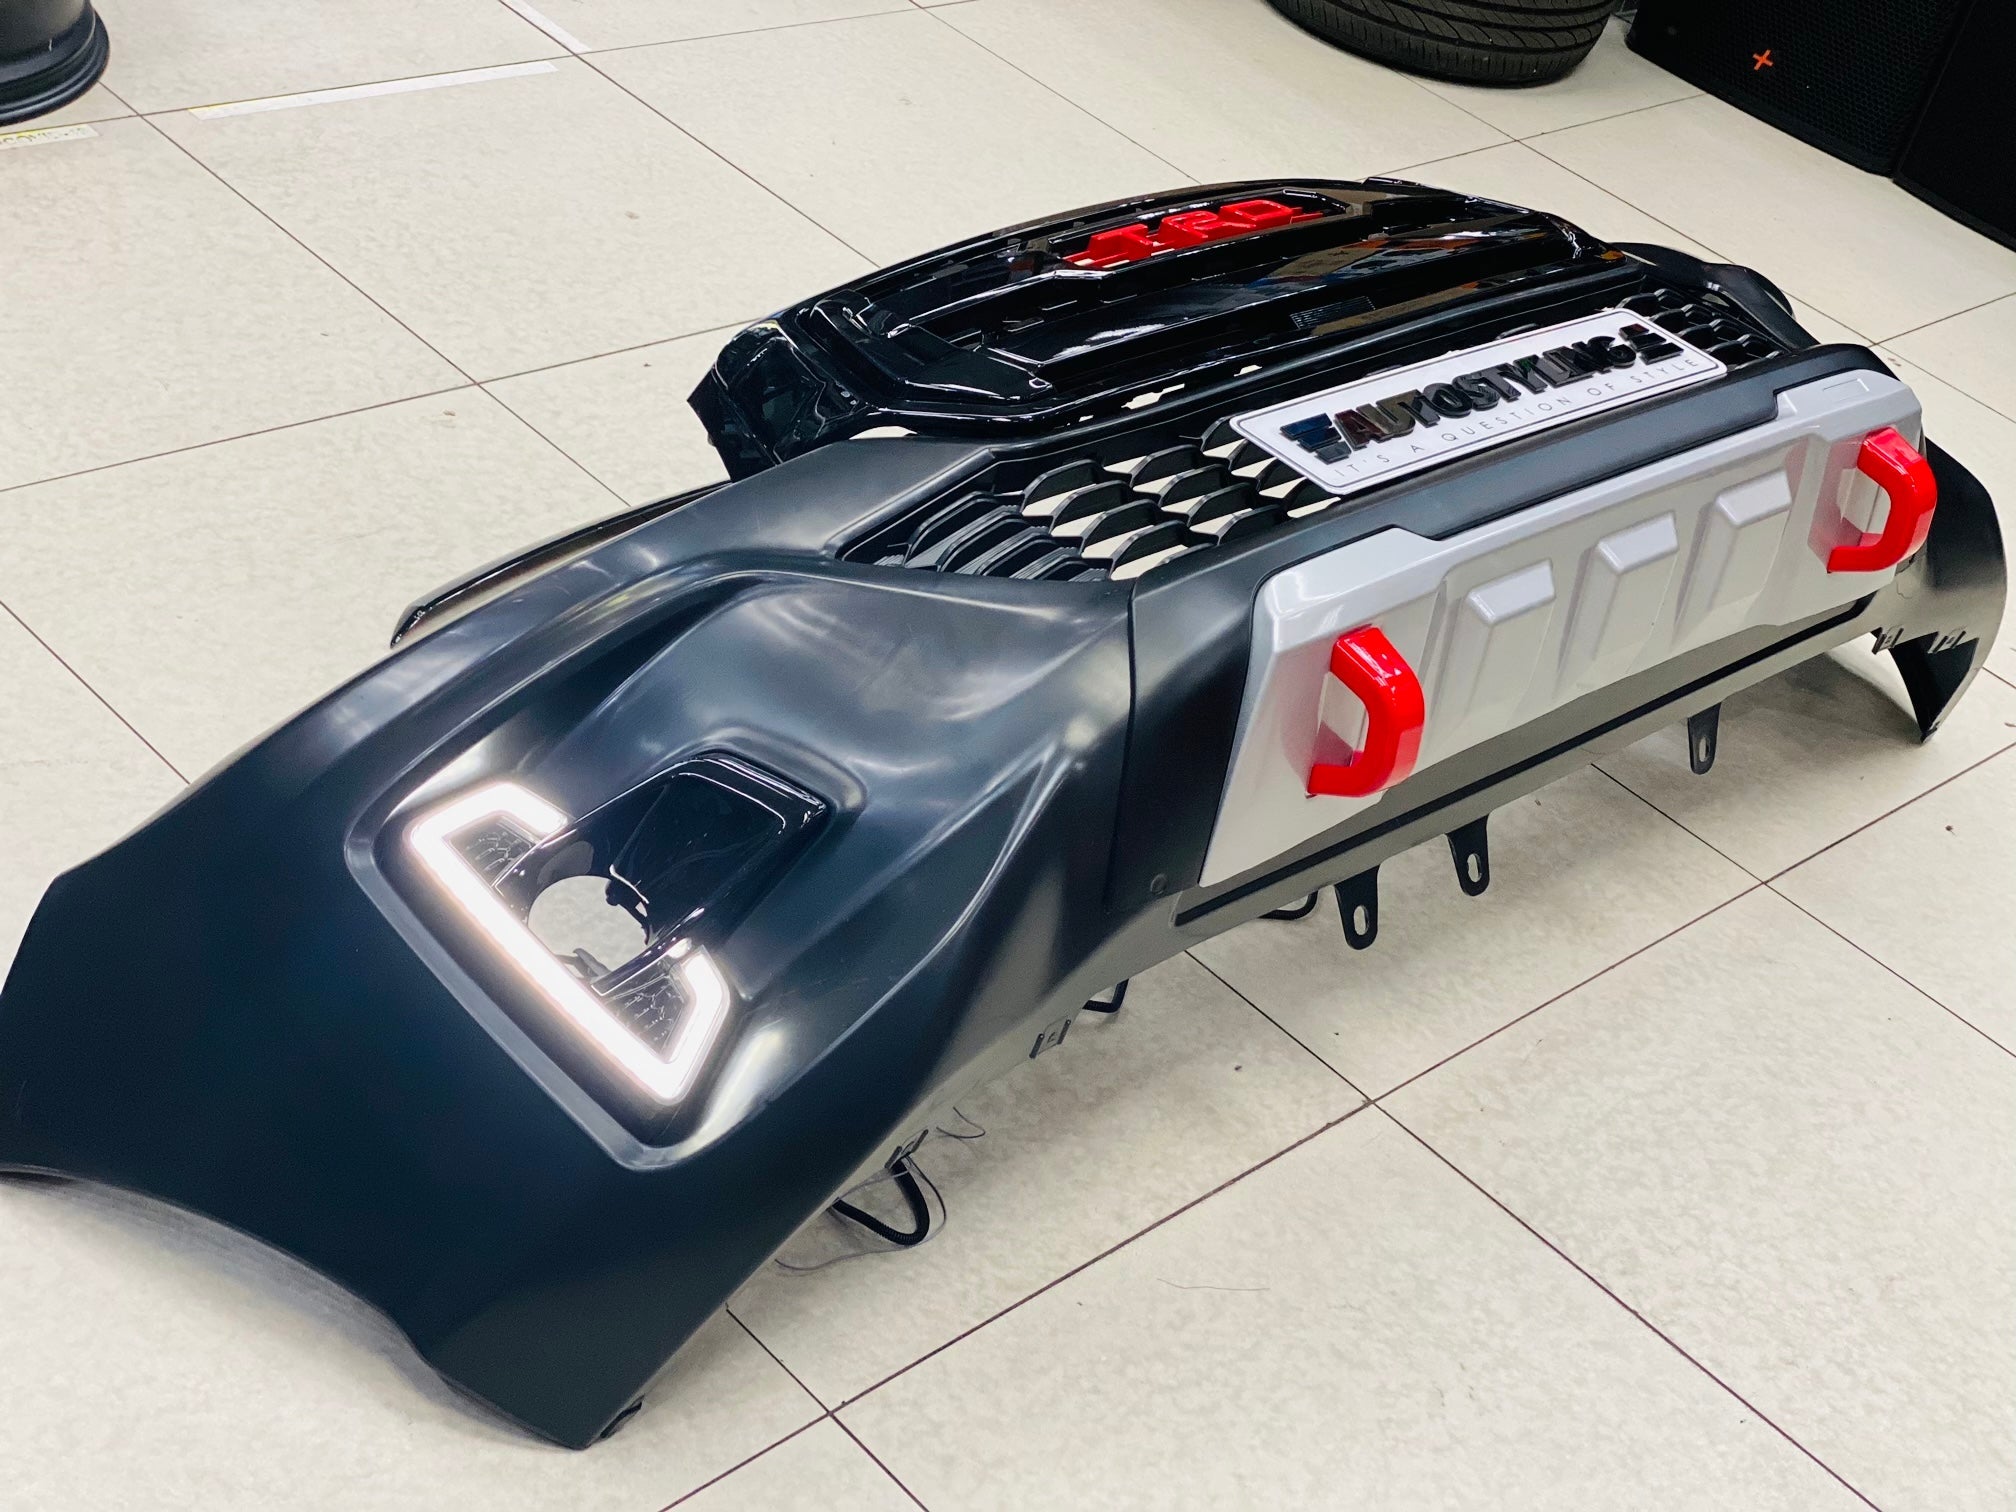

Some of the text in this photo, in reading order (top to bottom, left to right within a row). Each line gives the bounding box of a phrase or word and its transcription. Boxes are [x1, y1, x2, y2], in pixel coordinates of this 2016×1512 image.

[1080, 199, 1300, 266] TRD
[1333, 335, 1638, 451] AUTOSTYLING
[1334, 358, 1699, 478] IT'S A QUESTION OF STYLE
